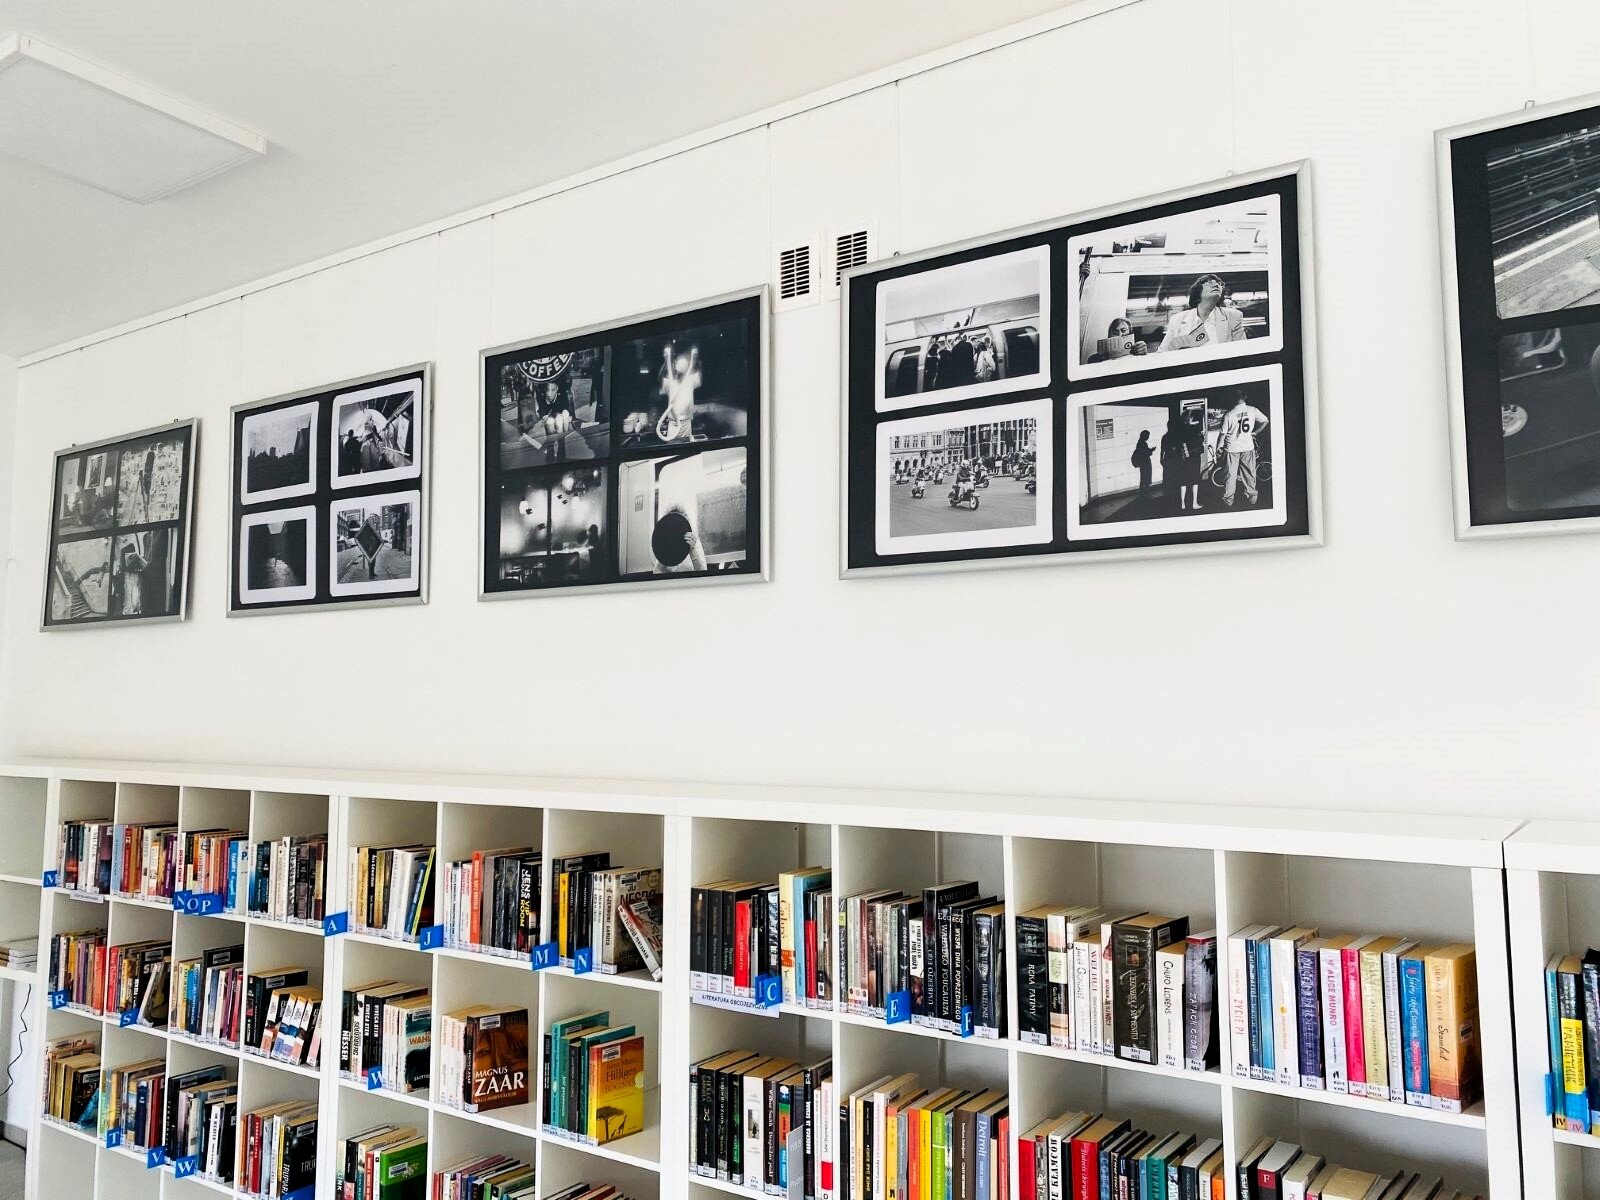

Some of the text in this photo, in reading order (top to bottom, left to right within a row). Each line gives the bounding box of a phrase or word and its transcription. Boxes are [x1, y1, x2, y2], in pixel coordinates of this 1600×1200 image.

[522, 354, 568, 378] COFFEE
[187, 898, 199, 910] O
[202, 900, 212, 912] P
[327, 920, 338, 932] A
[424, 932, 431, 946] J
[535, 950, 549, 966] M
[577, 953, 589, 970] N
[1163, 960, 1174, 984] CHUFO
[1434, 965, 1442, 993] ORHAN
[1328, 969, 1336, 994] ALICE
[767, 982, 777, 1001] C
[54, 994, 65, 1006] R
[702, 994, 768, 1010] LITERATURA OBCOJĘZYCZN
[1164, 987, 1174, 1014] LLORENS
[890, 1000, 899, 1018] E
[122, 1013, 131, 1024] S
[964, 1014, 973, 1032] F
[1235, 1026, 1244, 1035] PI
[1412, 1040, 1420, 1062] Sharon
[370, 1070, 382, 1086] W
[475, 1066, 508, 1078] MAGNUS
[606, 1067, 638, 1082] Hilliges
[475, 1071, 524, 1096] ZAAR
[1556, 1118, 1566, 1126] IV
[1572, 1123, 1582, 1132] IV
[108, 1132, 120, 1144] T
[978, 1121, 987, 1157] Detroit
[151, 1150, 162, 1164] V
[177, 1160, 194, 1174] W
[1263, 1174, 1270, 1183] F
